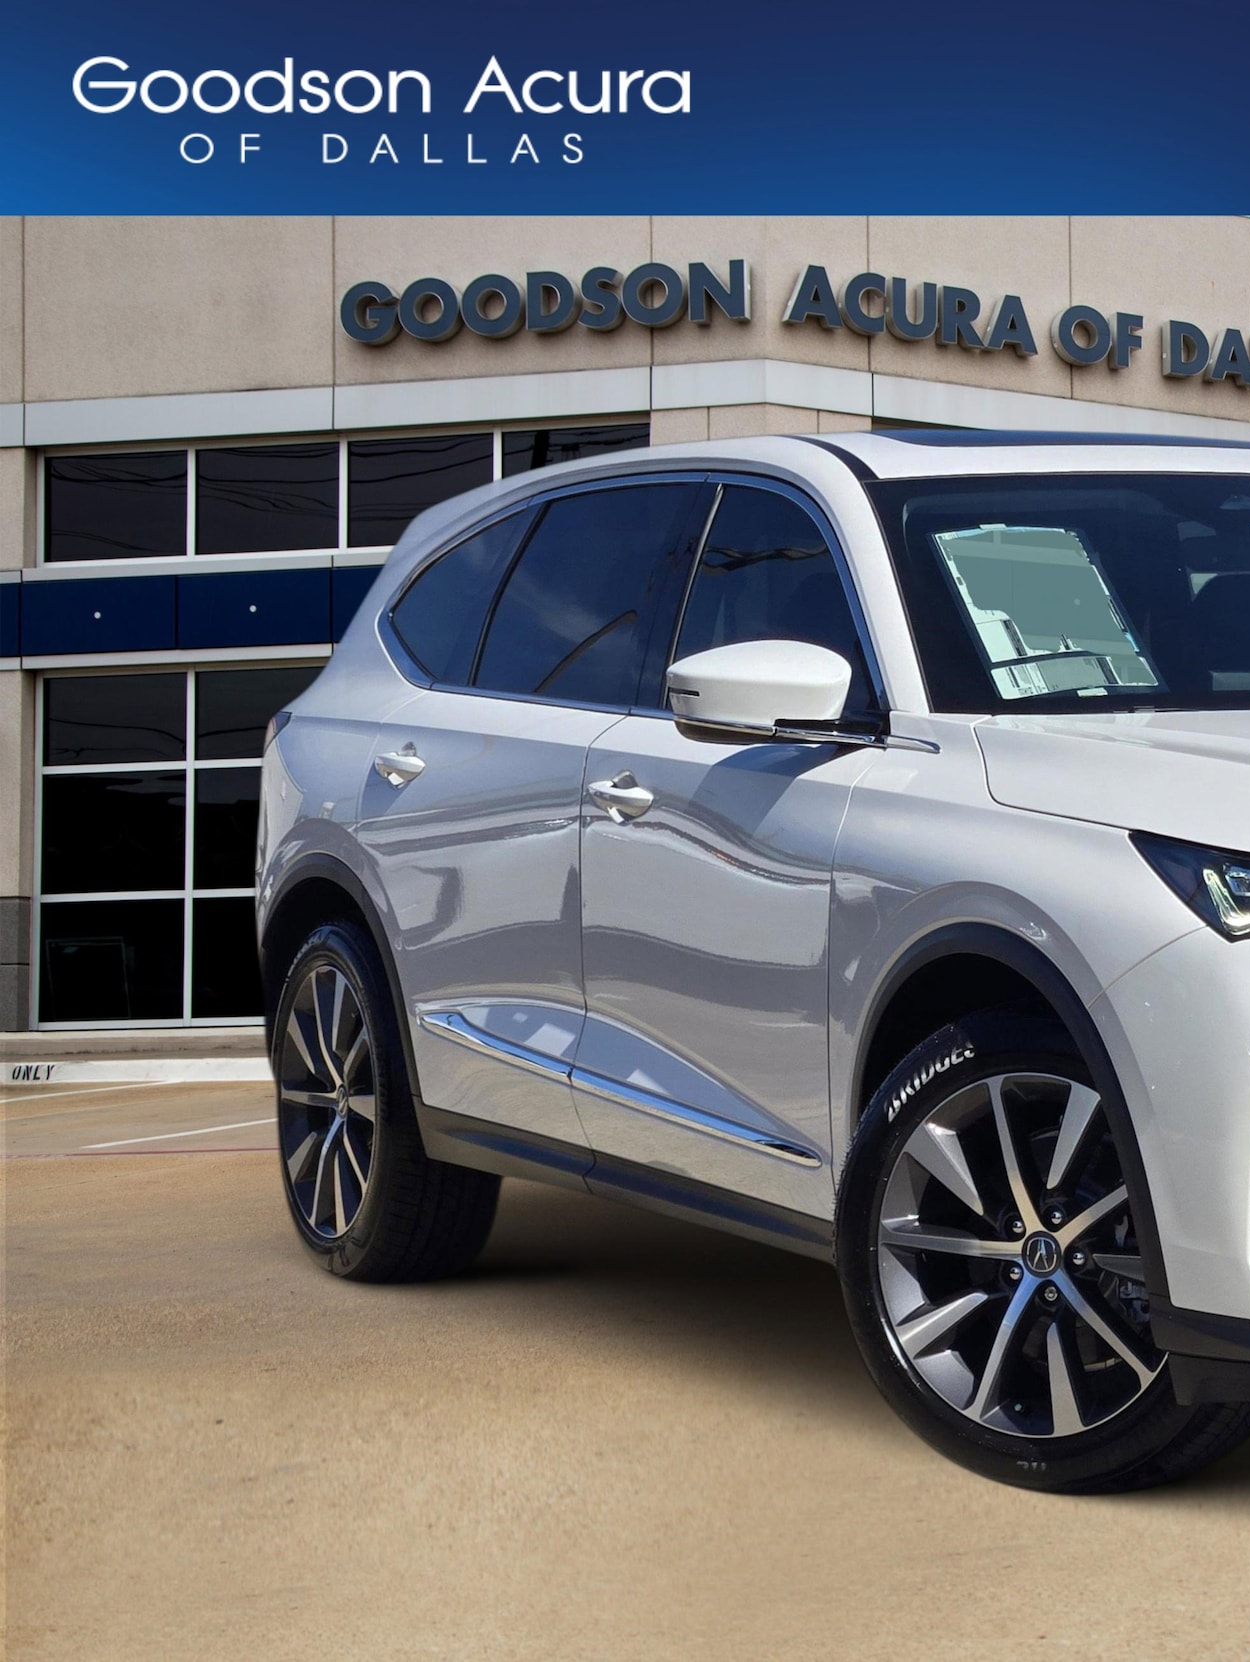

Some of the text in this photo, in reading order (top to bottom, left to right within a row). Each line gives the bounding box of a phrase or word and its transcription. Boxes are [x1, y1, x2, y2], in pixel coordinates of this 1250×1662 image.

[340, 259, 751, 346] GOODSON
[782, 264, 1039, 357] ACURA
[1051, 304, 1144, 369] OF
[11, 1064, 56, 1081] ONLY
